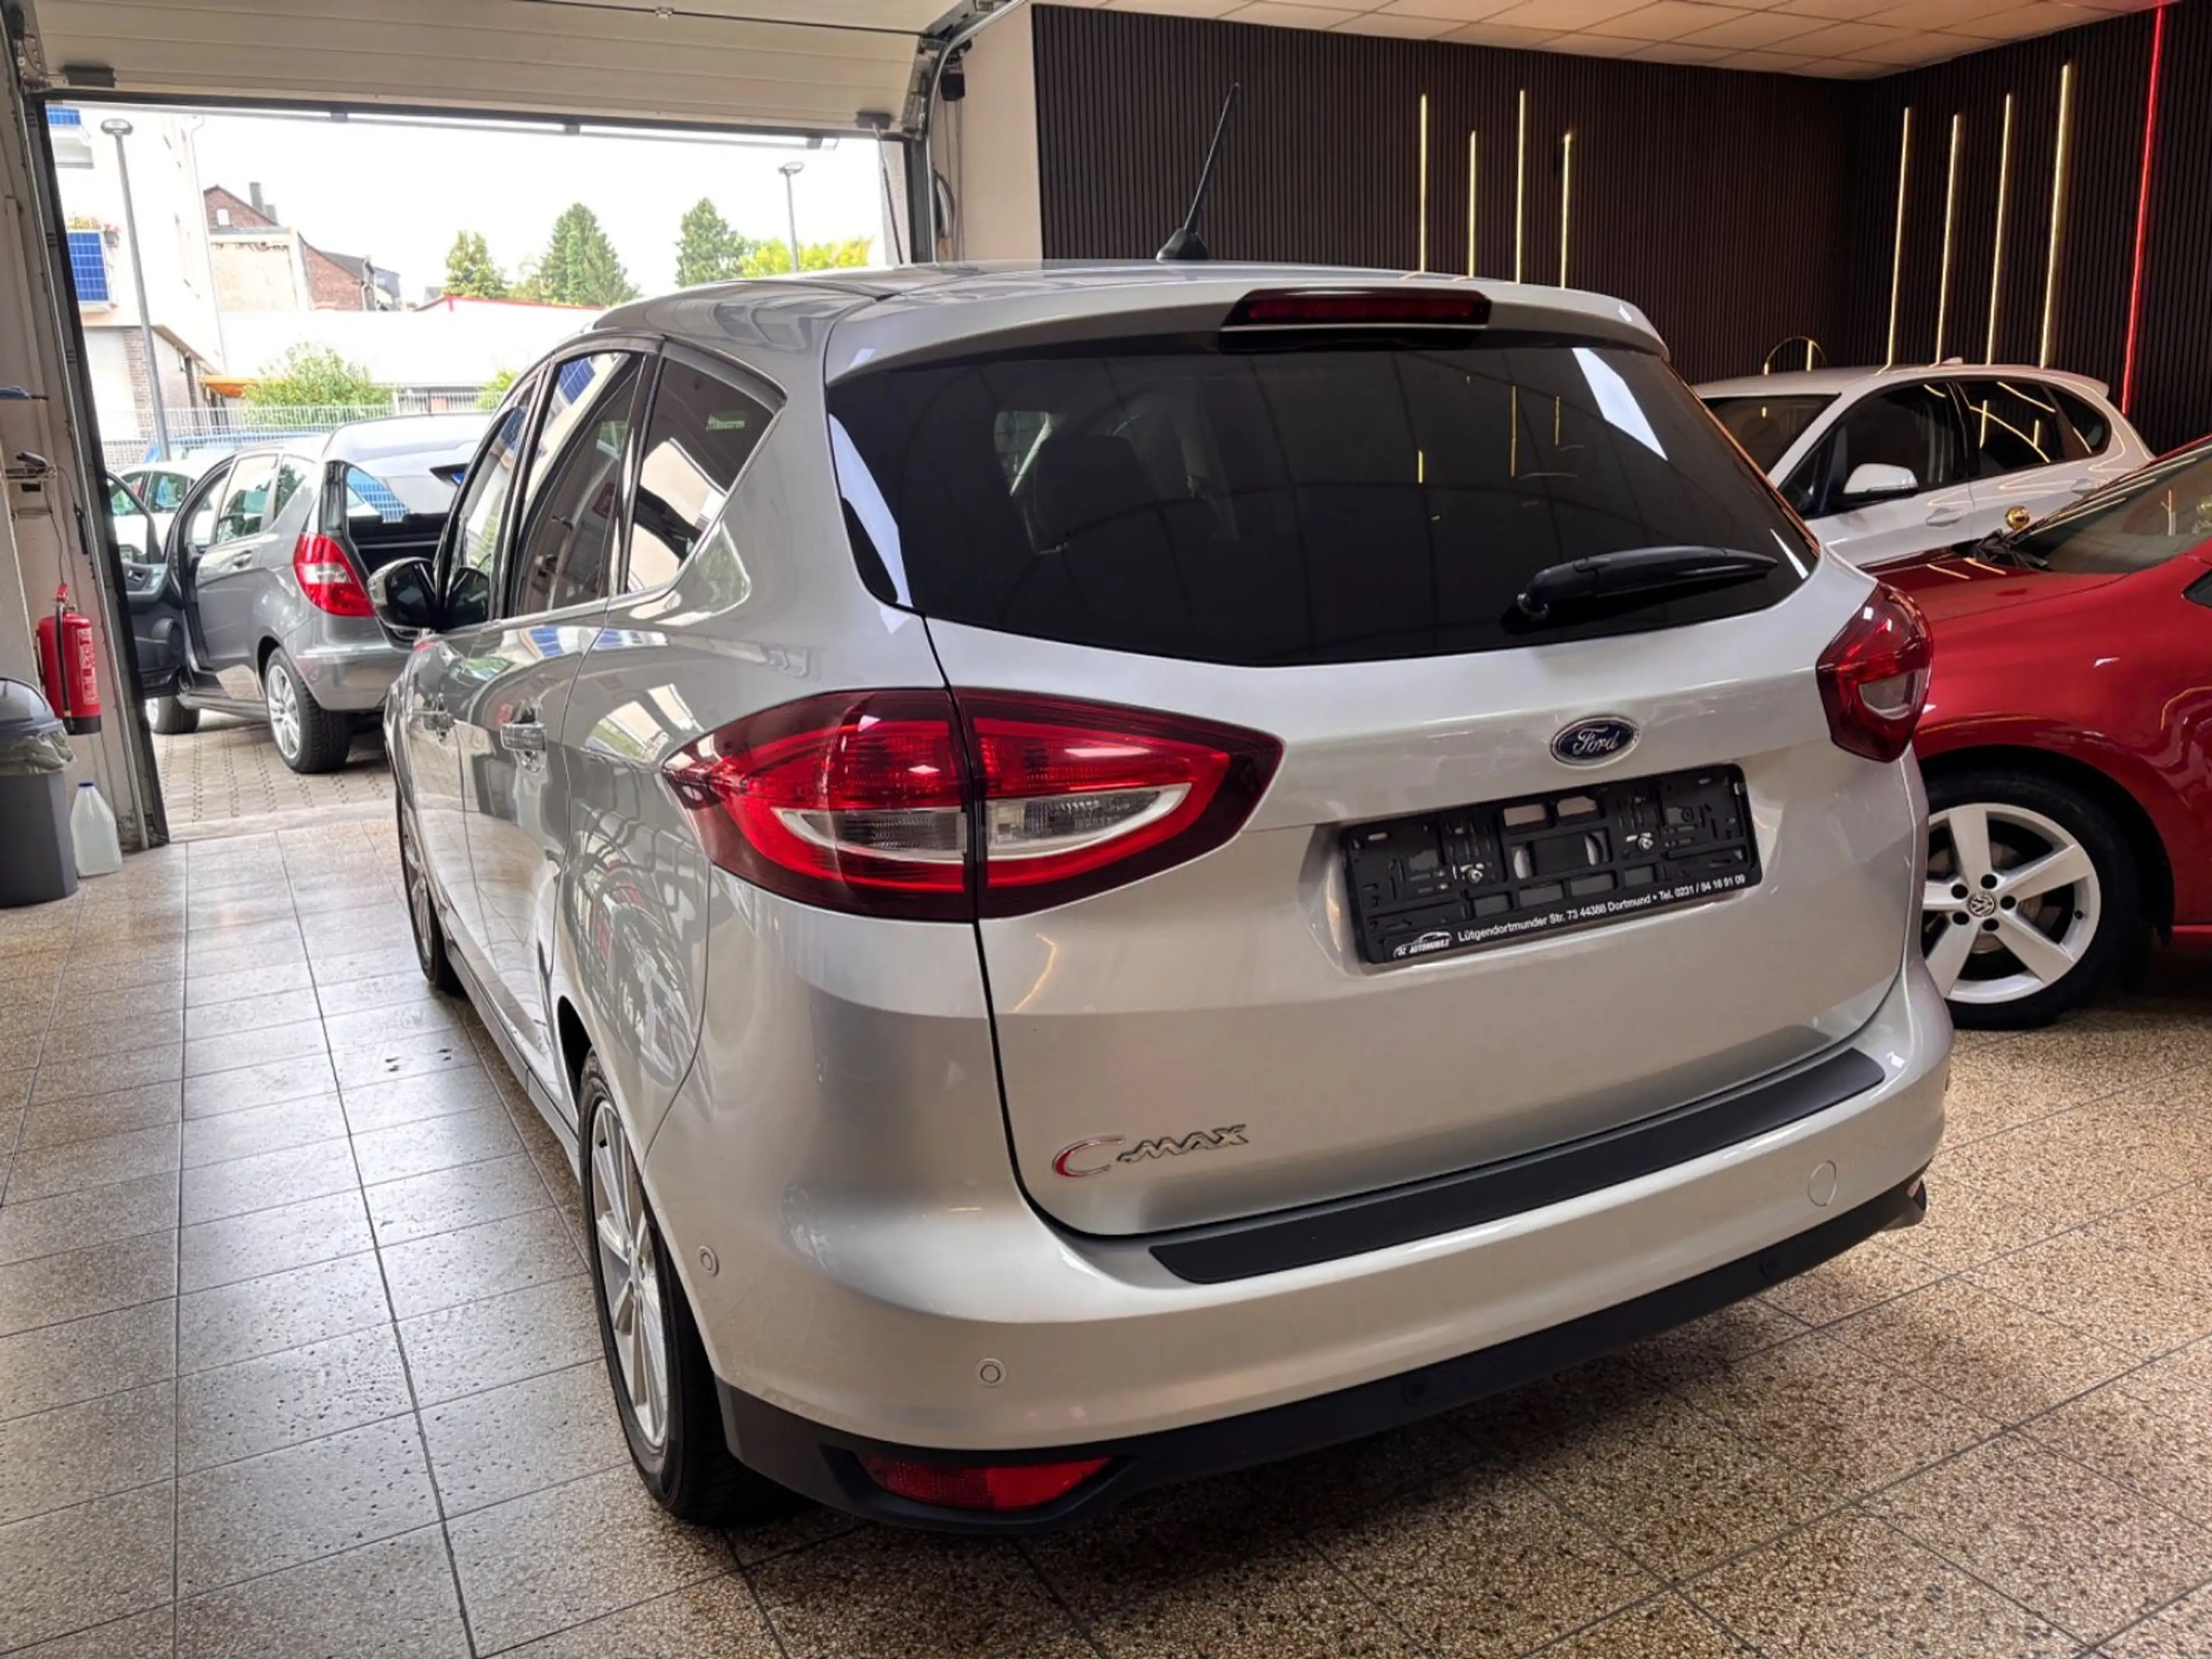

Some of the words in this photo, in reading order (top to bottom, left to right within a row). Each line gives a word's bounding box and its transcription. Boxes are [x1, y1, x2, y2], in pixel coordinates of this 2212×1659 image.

[1572, 726, 1620, 755] Ford
[1548, 912, 1565, 925] Str.
[1567, 910, 1578, 921] 73
[1608, 895, 1651, 912] Dortmund
[1659, 891, 1674, 900] Tel.
[1675, 885, 1695, 897] 0231
